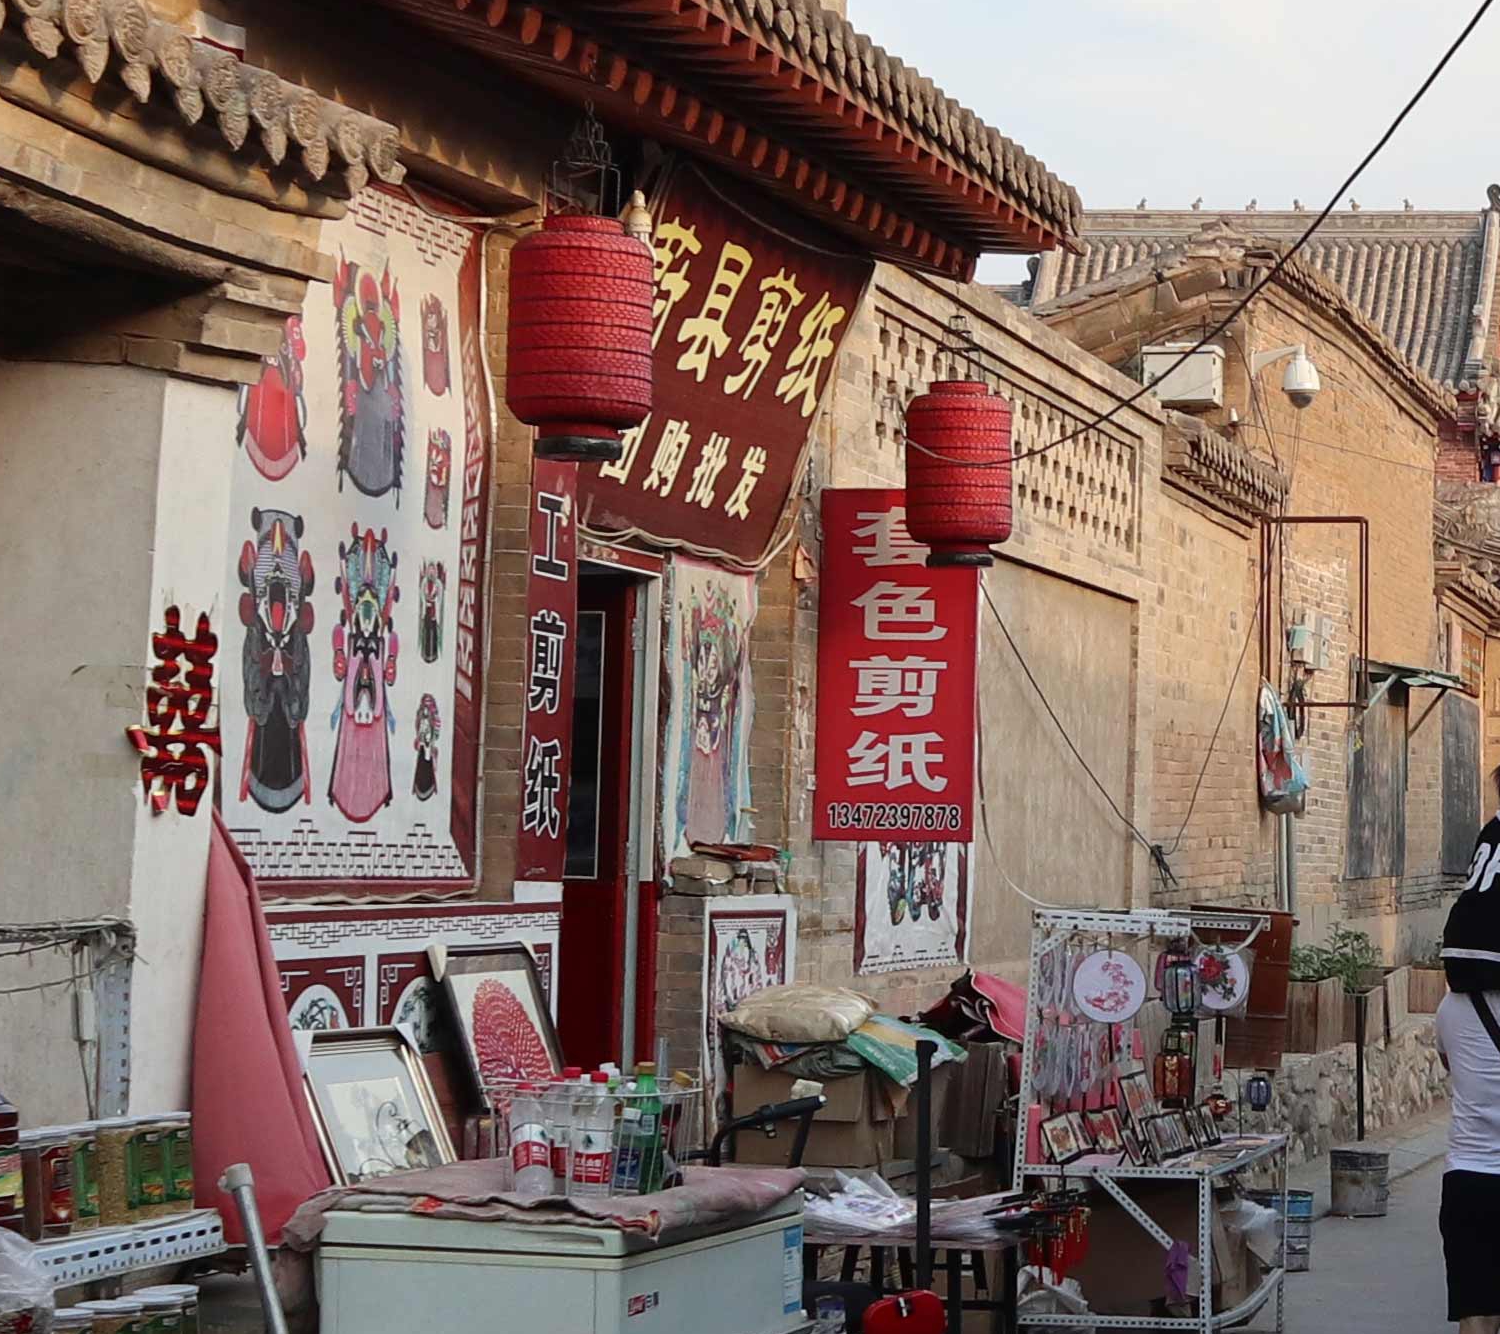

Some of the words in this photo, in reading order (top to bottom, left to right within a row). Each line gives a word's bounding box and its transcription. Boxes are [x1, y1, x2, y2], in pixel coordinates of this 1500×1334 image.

[846, 505, 949, 793] 套色剪纸
[827, 802, 962, 831] 13472397878
